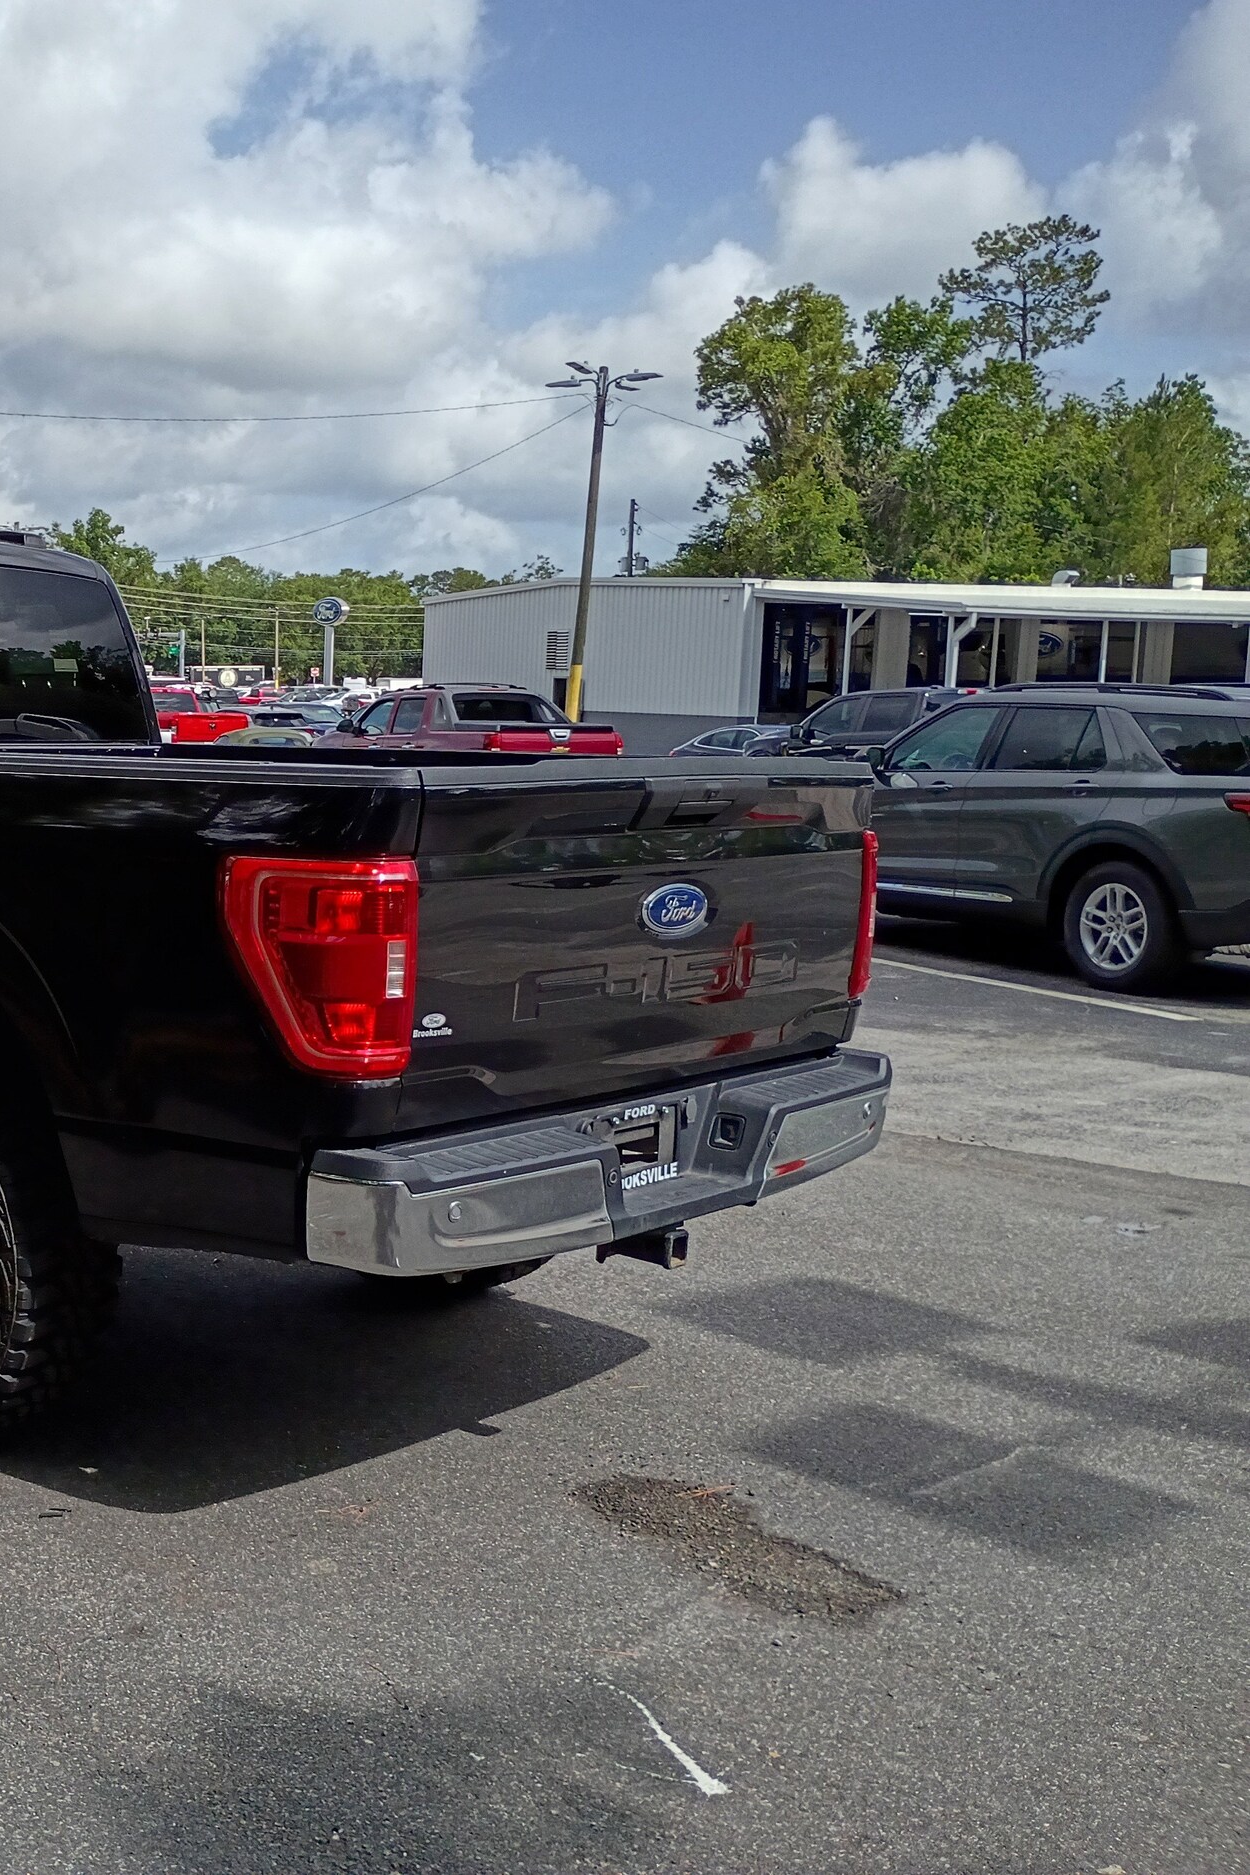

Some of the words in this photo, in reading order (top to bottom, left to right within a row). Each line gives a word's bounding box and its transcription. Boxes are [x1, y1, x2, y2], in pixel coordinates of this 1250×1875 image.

[661, 895, 696, 922] Ford
[513, 938, 798, 1022] F-150
[412, 1027, 452, 1038] Brooksville
[624, 1104, 656, 1121] FORD
